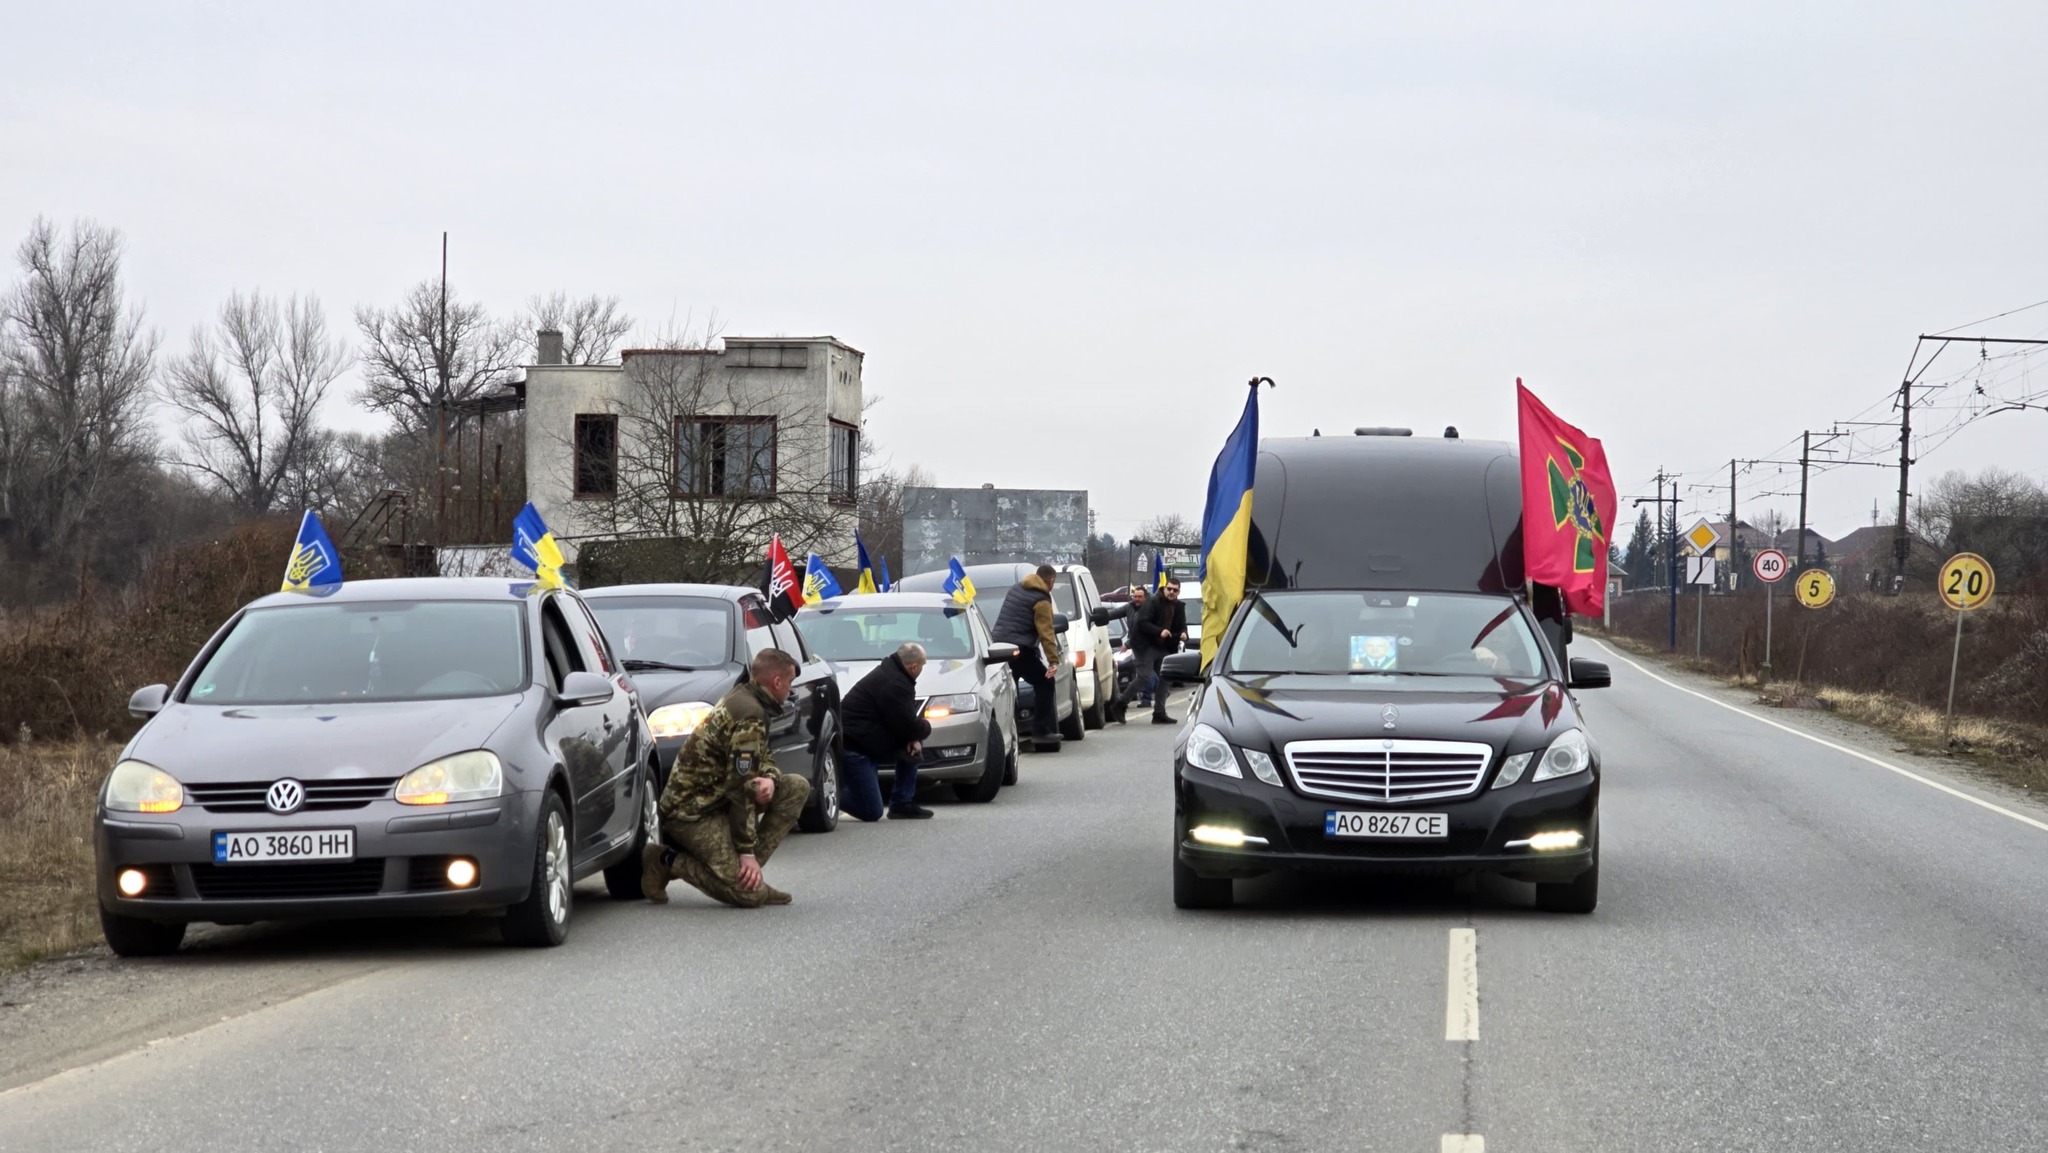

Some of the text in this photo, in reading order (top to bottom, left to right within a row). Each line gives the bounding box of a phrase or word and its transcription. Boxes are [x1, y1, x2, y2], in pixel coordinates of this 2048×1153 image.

[1762, 559, 1779, 572] 40
[1808, 579, 1820, 598] 5
[1947, 568, 1983, 596] 20
[1337, 814, 1442, 835] AO 8267 CE
[217, 850, 227, 858] UA
[229, 834, 348, 858] AO 3860 HH
